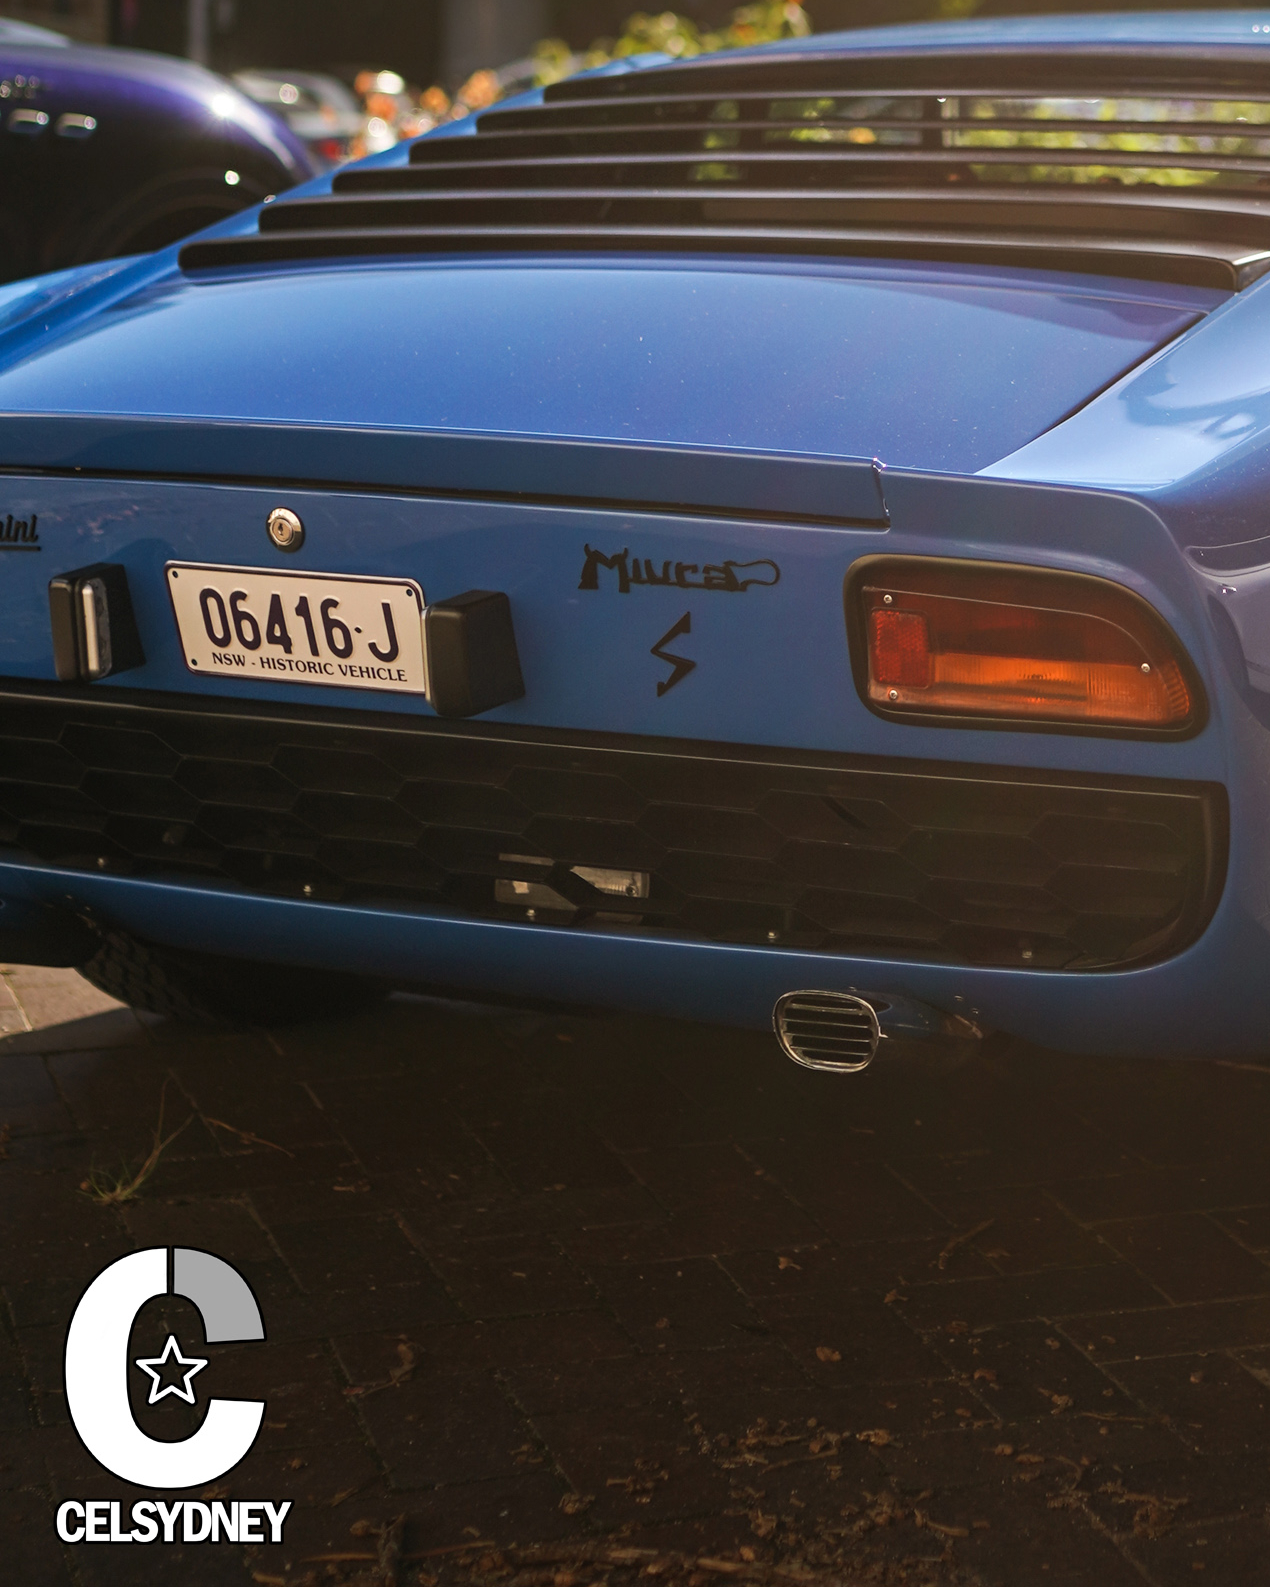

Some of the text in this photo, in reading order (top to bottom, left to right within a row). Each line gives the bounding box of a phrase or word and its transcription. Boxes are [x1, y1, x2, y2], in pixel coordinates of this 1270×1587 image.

[578, 543, 780, 594] Miura
[212, 652, 246, 668] NSW
[260, 656, 335, 676] HISTORIC
[338, 664, 408, 682] VEHICLE
[650, 611, 697, 698] S
